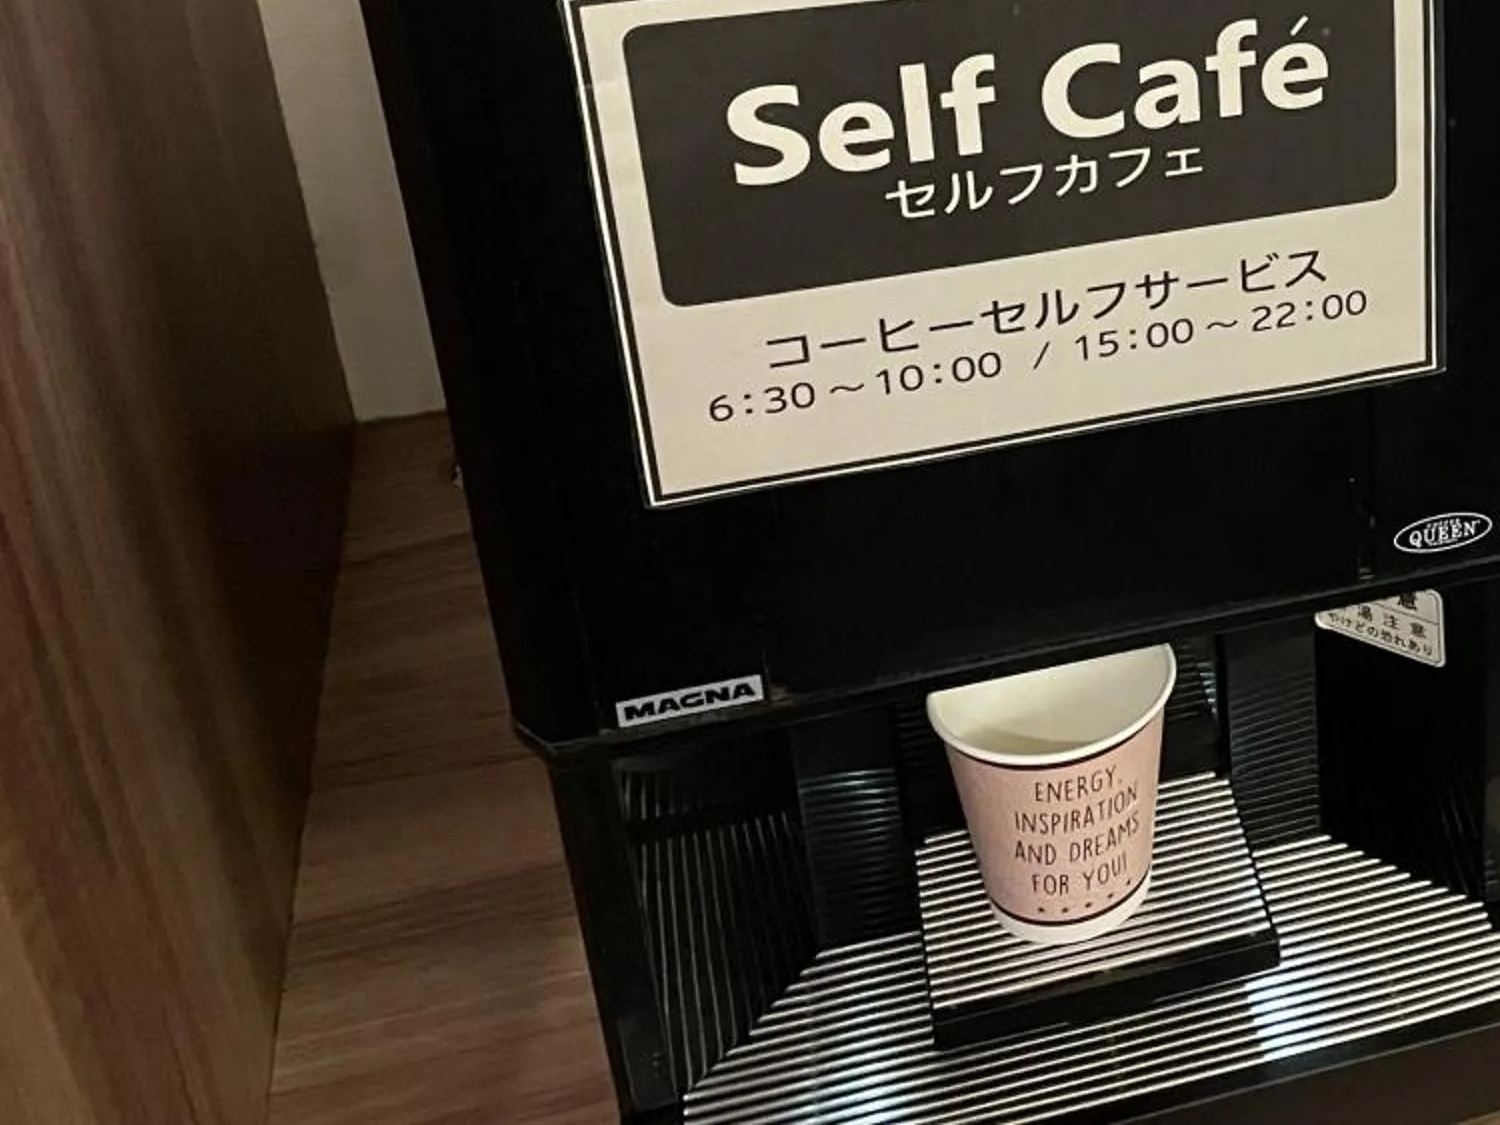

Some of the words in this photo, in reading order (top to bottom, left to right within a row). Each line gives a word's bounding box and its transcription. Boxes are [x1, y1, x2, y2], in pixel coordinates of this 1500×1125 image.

[725, 52, 998, 187] Self
[1040, 14, 1330, 140] Café
[885, 145, 1204, 220] セルフカフェ
[766, 248, 1327, 370] コーヒーセルフサービス
[1409, 520, 1476, 548] QUEEN
[623, 682, 756, 721] MAGNA
[1014, 784, 1138, 836] INSPIRATION
[1013, 841, 1057, 866] AND
[1068, 813, 1140, 863] DREAMS
[1031, 873, 1070, 896] FOR
